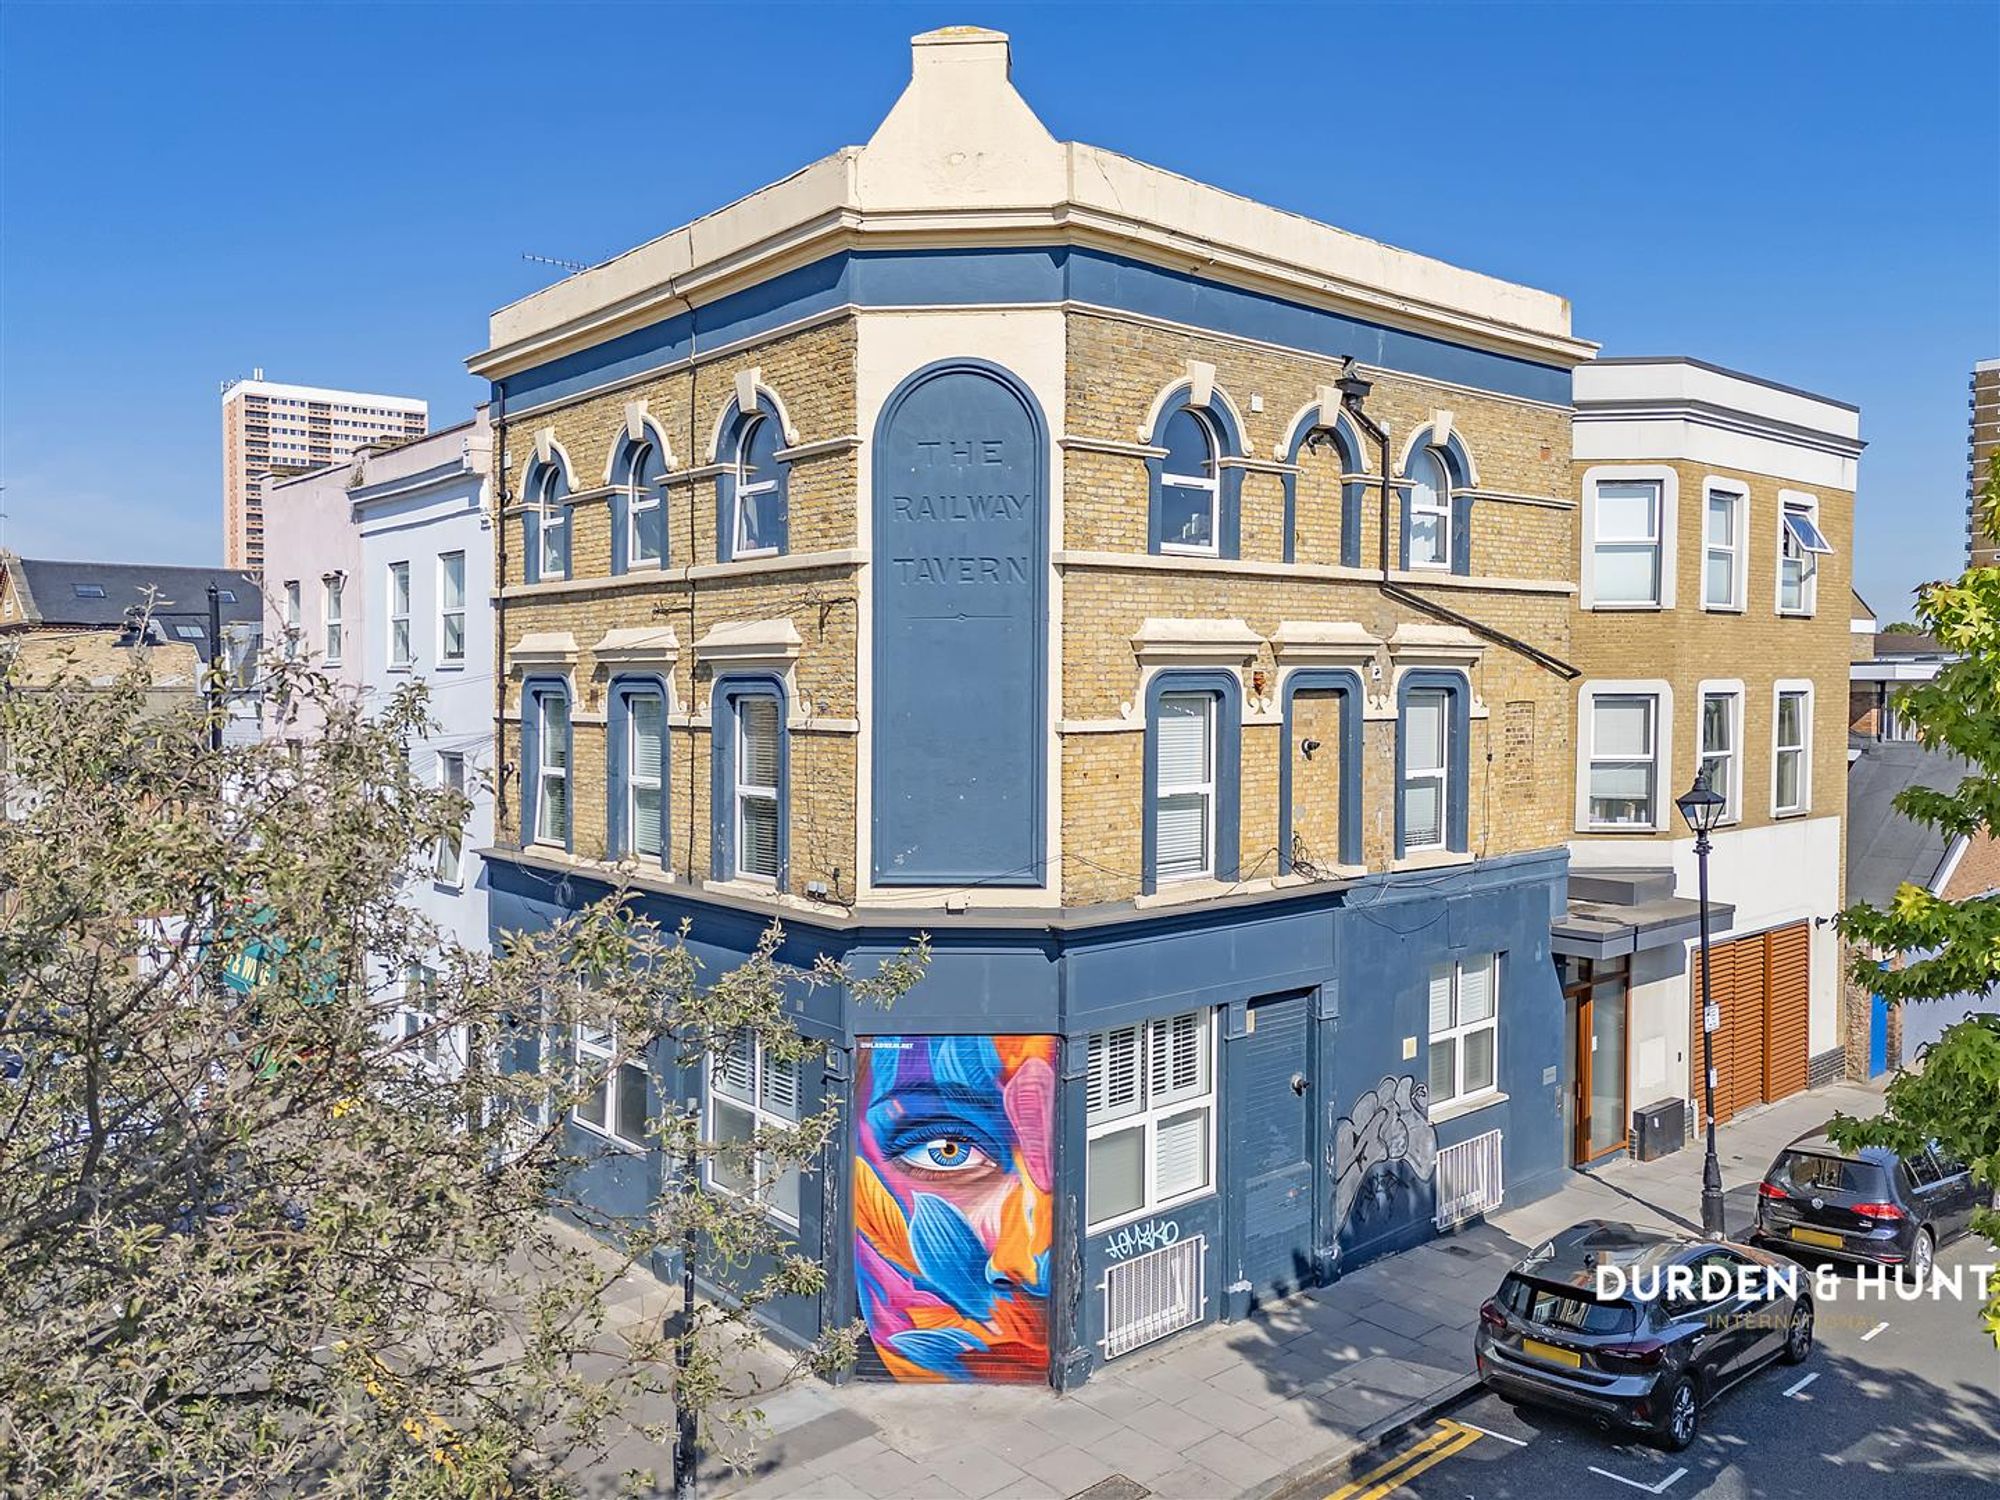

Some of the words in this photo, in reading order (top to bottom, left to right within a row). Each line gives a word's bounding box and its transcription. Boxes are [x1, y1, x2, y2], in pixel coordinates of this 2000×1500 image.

[917, 440, 1003, 467] THE
[892, 494, 1032, 522] RAILWAY
[892, 556, 1028, 585] TAVERN
